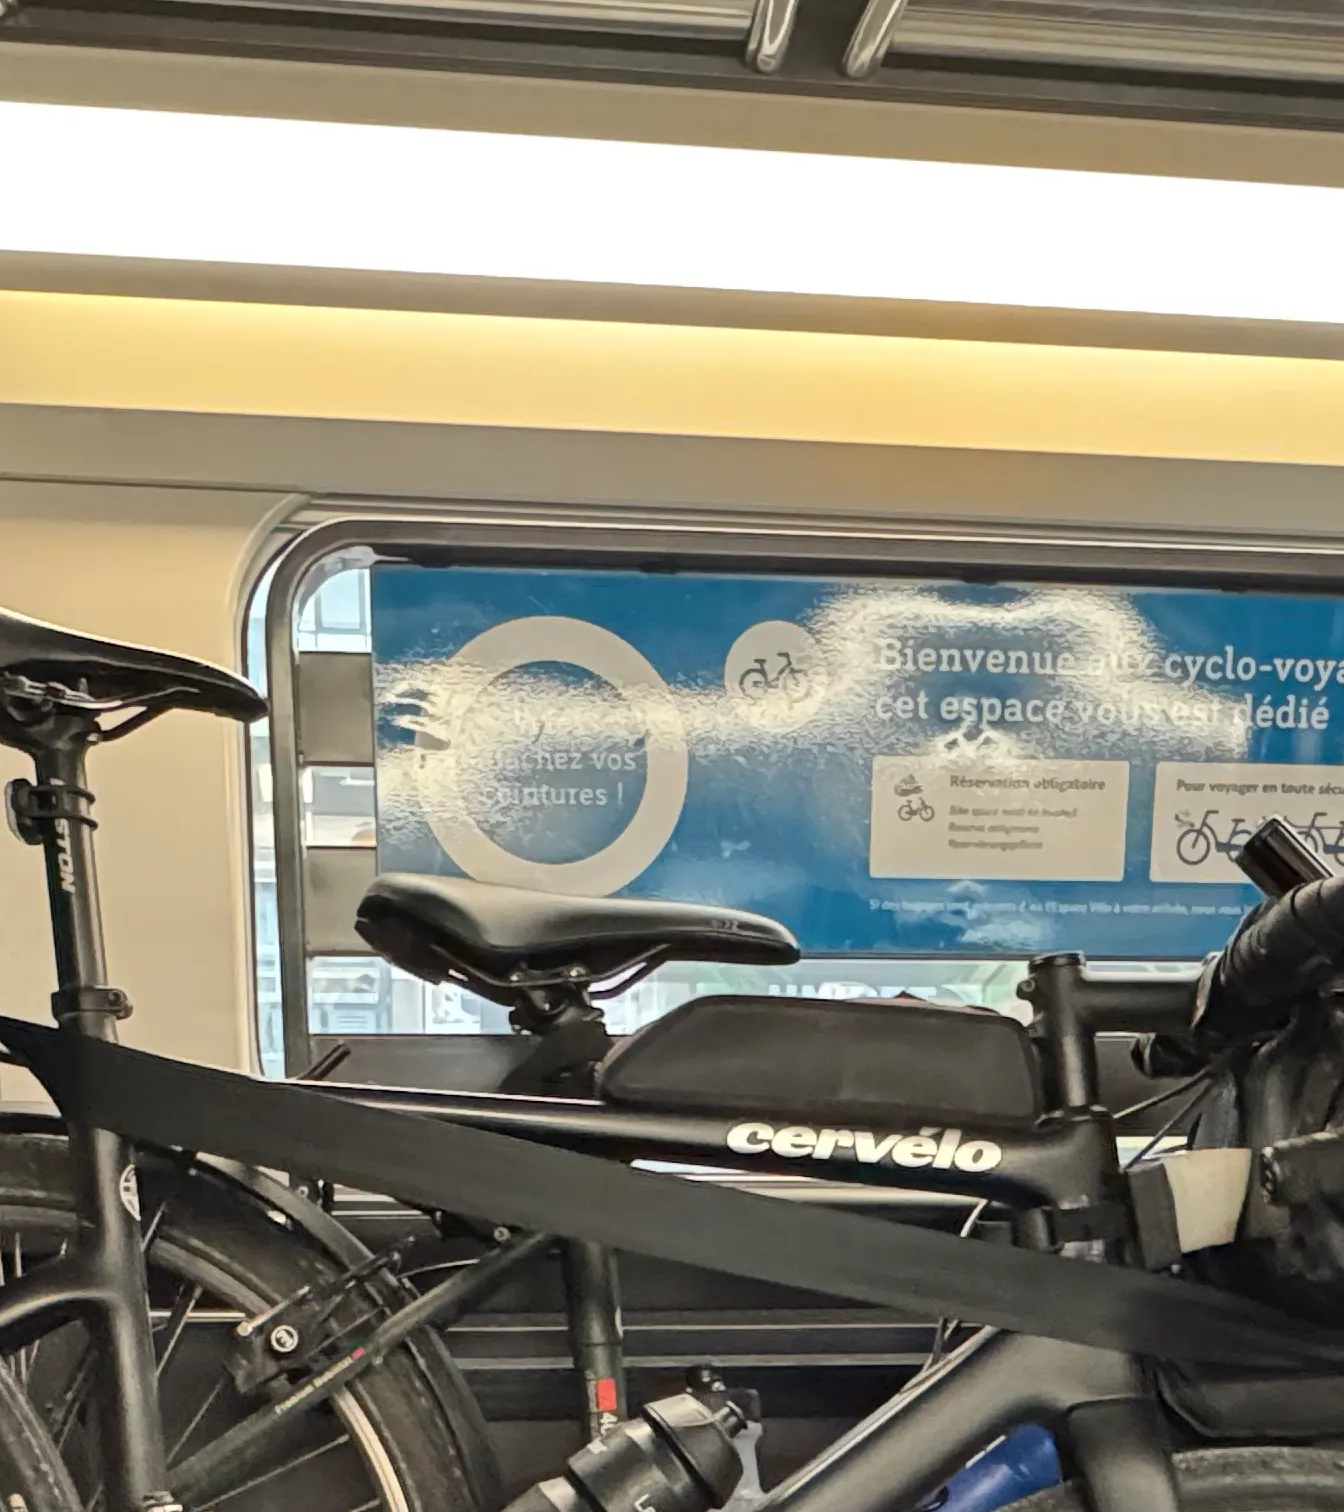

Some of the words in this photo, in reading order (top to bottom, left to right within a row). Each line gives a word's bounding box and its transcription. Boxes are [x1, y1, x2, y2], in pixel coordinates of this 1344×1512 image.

[877, 637, 1075, 675] Bienvenue
[876, 689, 929, 720] cet
[940, 695, 1066, 729] espace
[1238, 693, 1330, 729] dédié
[590, 752, 636, 771] vos
[1176, 778, 1205, 792] Pour
[1209, 782, 1259, 795] voyager
[1262, 783, 1277, 793] en
[1281, 782, 1315, 794] toute
[726, 1122, 1002, 1172] cervélo
